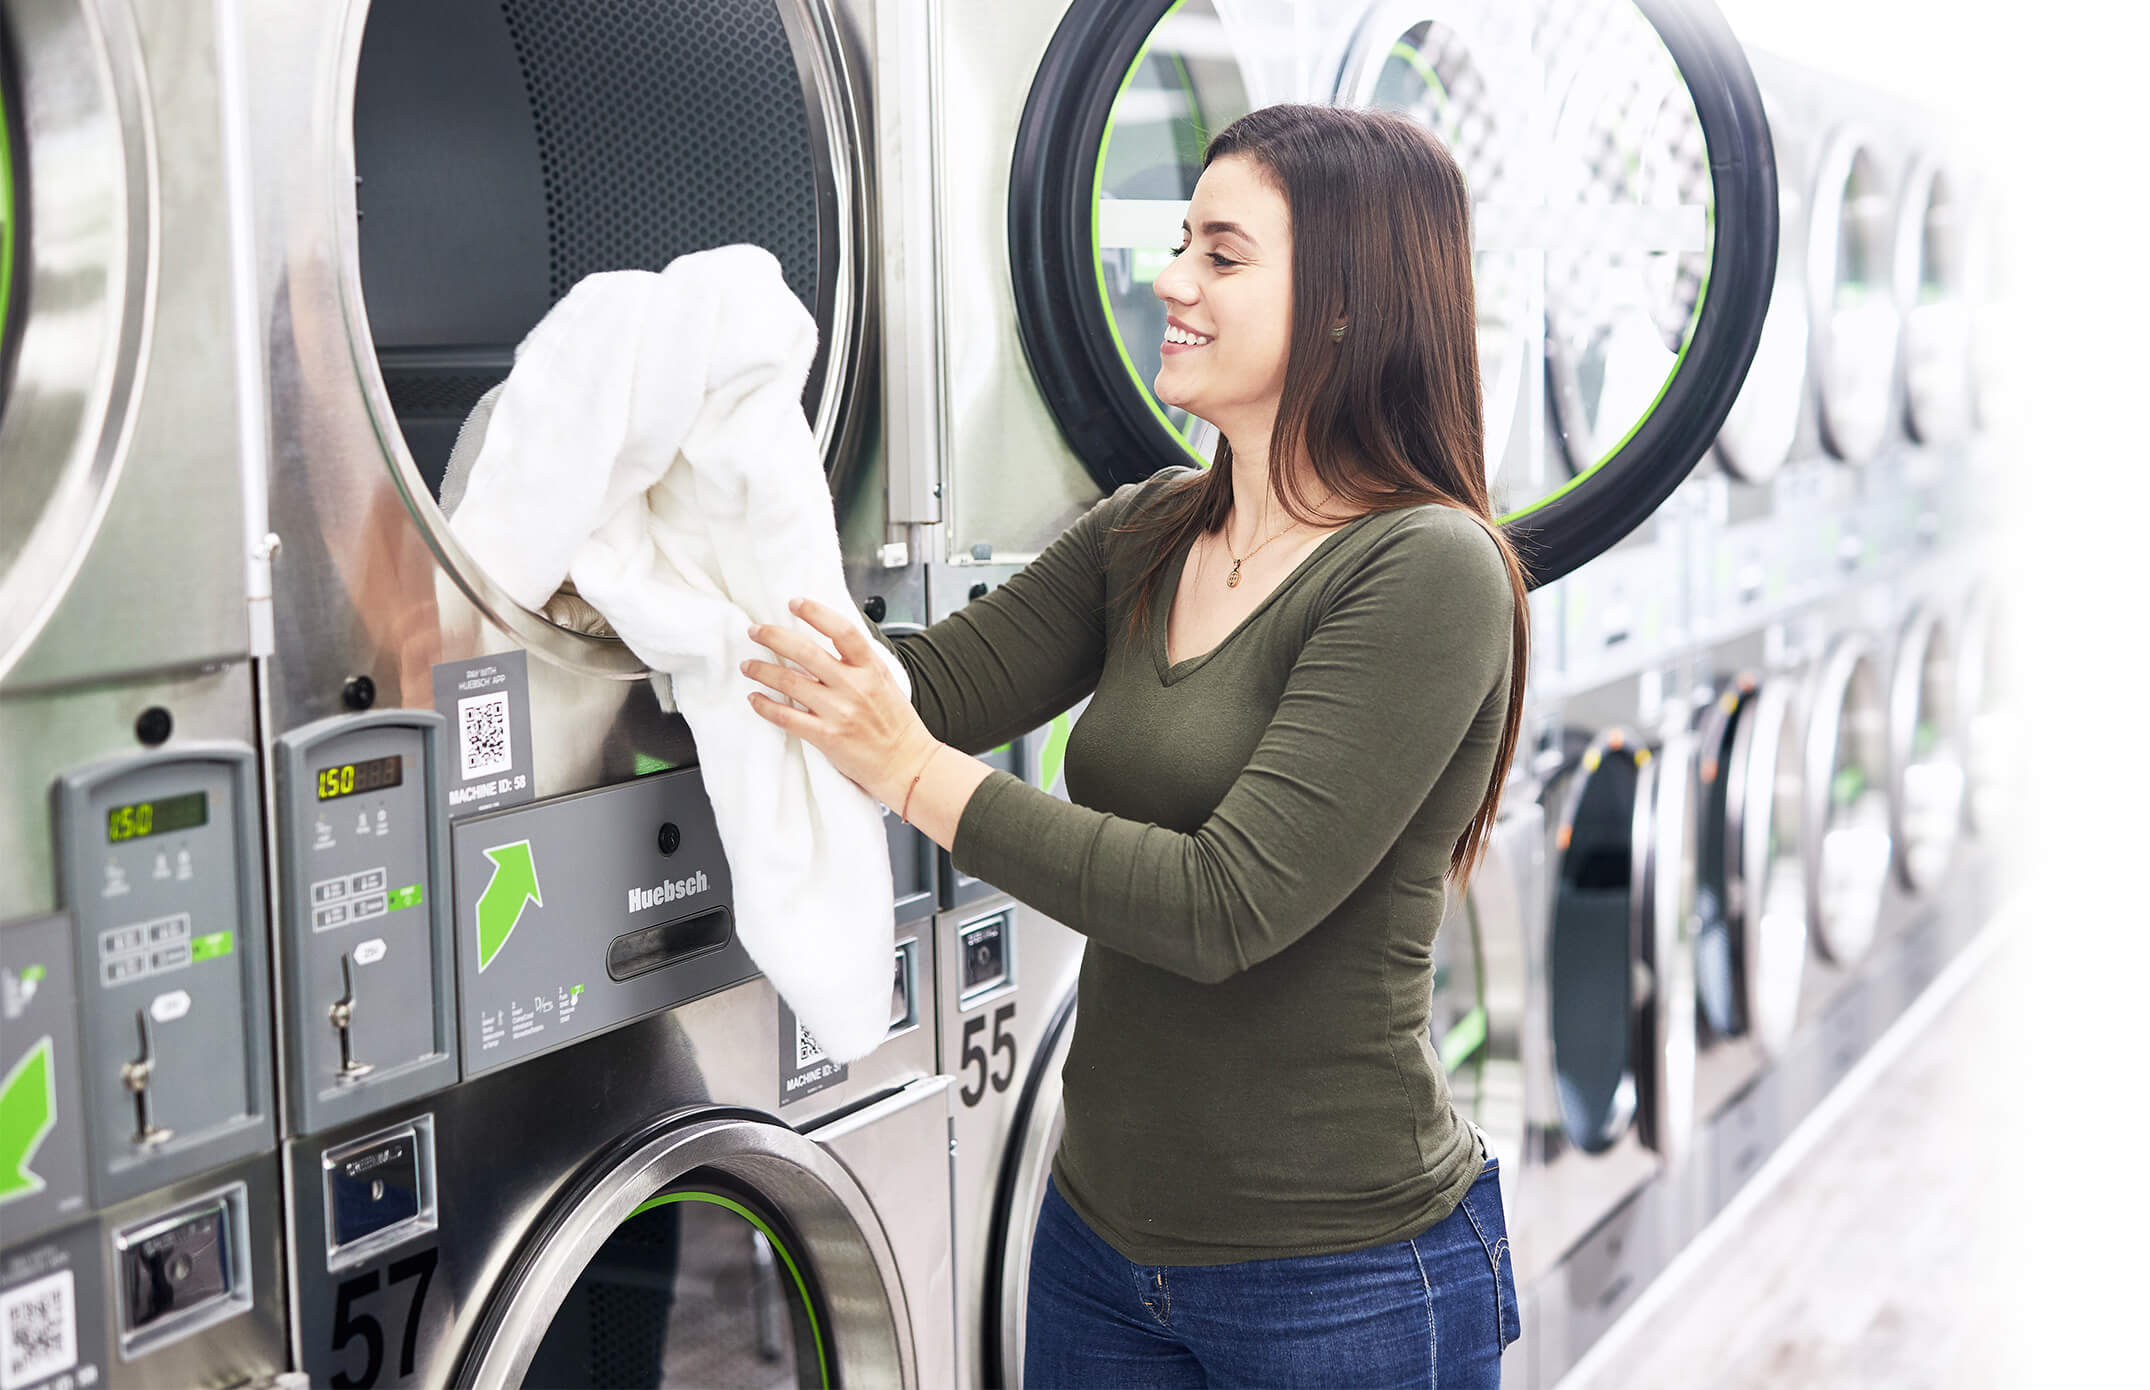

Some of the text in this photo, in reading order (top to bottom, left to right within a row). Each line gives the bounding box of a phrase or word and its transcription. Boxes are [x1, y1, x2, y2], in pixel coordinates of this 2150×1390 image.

[449, 774, 526, 806] MACHINE ID: 58
[628, 870, 708, 913] Huebsch
[960, 1002, 1017, 1108] 55
[787, 1067, 822, 1092] MACHINE
[329, 1246, 439, 1390] 57
